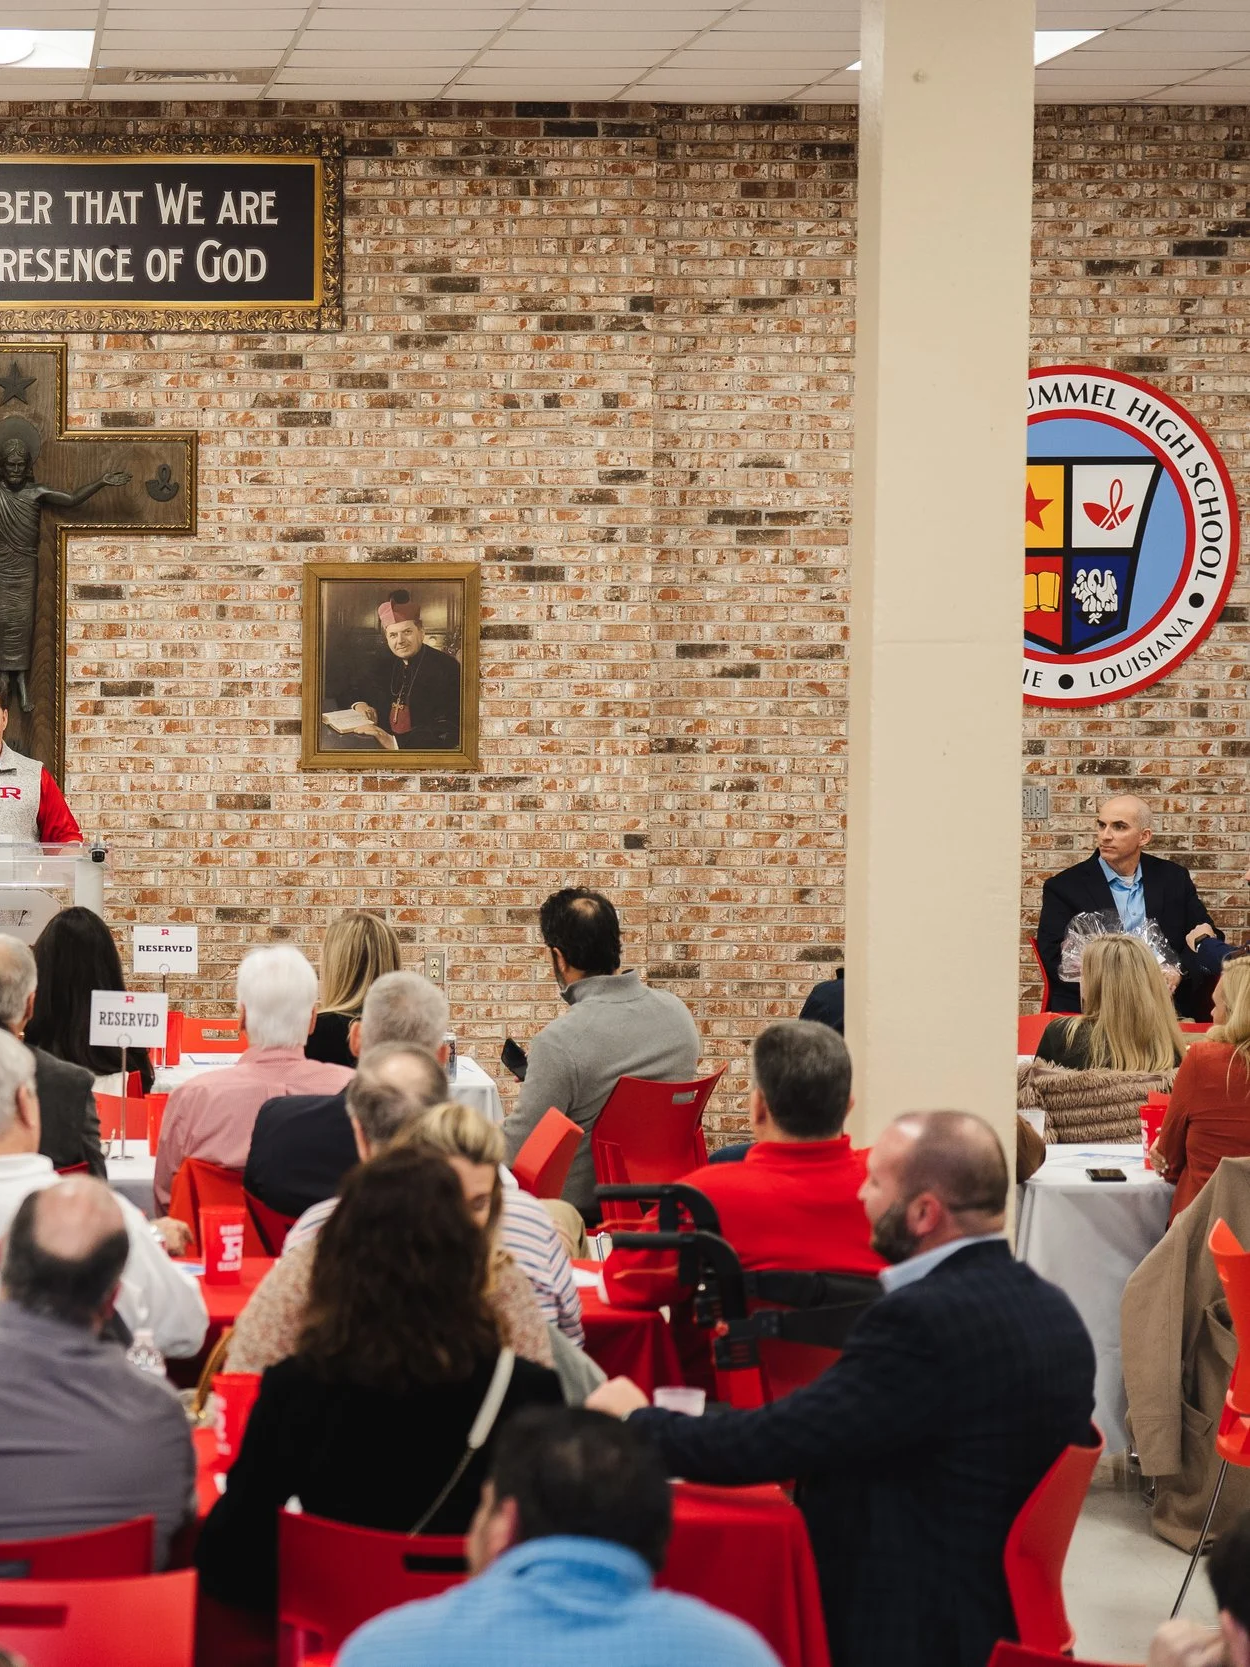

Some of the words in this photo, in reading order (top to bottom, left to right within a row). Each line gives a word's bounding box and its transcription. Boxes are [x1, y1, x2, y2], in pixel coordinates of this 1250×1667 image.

[62, 189, 145, 226] THAT
[153, 181, 207, 226] WE
[214, 189, 280, 226] ARE
[144, 247, 186, 284] OF
[195, 238, 268, 284] GOD
[1126, 397, 1195, 460] HIGH
[1186, 461, 1224, 582] SCHOOL
[1089, 617, 1194, 688] LOUISIANA
[0, 786, 22, 800] R
[161, 928, 170, 936] R
[138, 944, 193, 953] RESERVED
[98, 1011, 159, 1028] RESERVED
